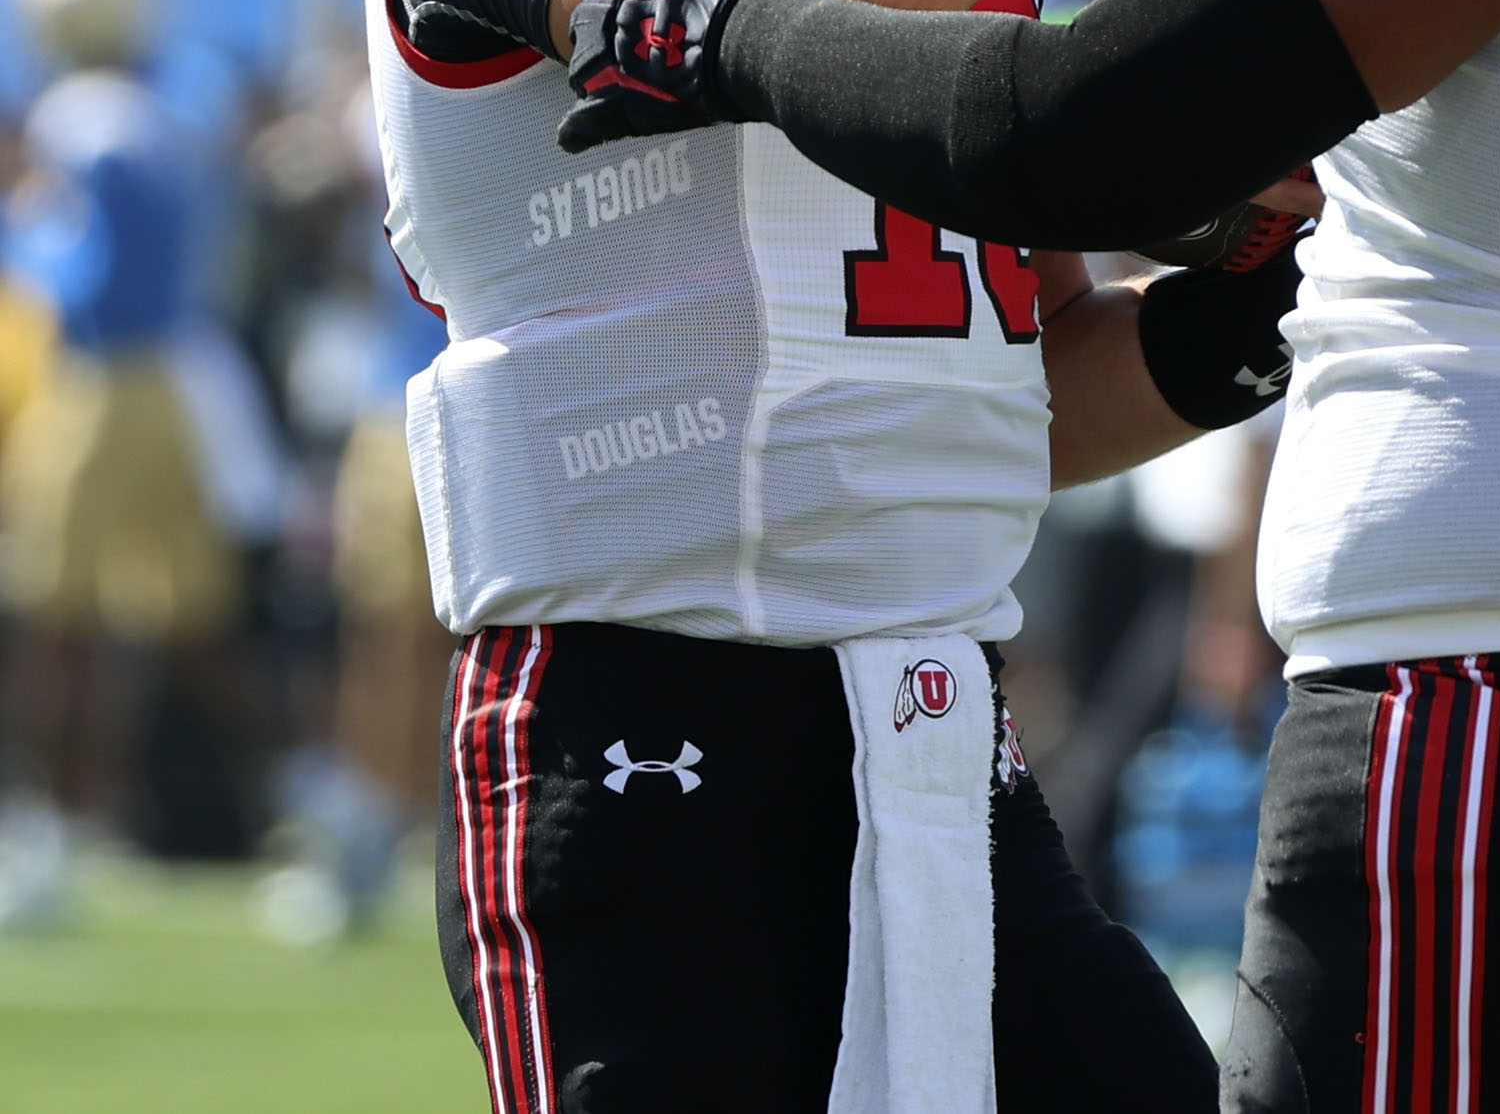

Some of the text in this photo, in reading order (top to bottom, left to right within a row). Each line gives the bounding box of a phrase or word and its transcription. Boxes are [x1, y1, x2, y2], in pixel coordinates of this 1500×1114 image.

[529, 139, 693, 247] DOUGLAS
[559, 397, 728, 480] DOUGLAS
[917, 671, 948, 711] U
